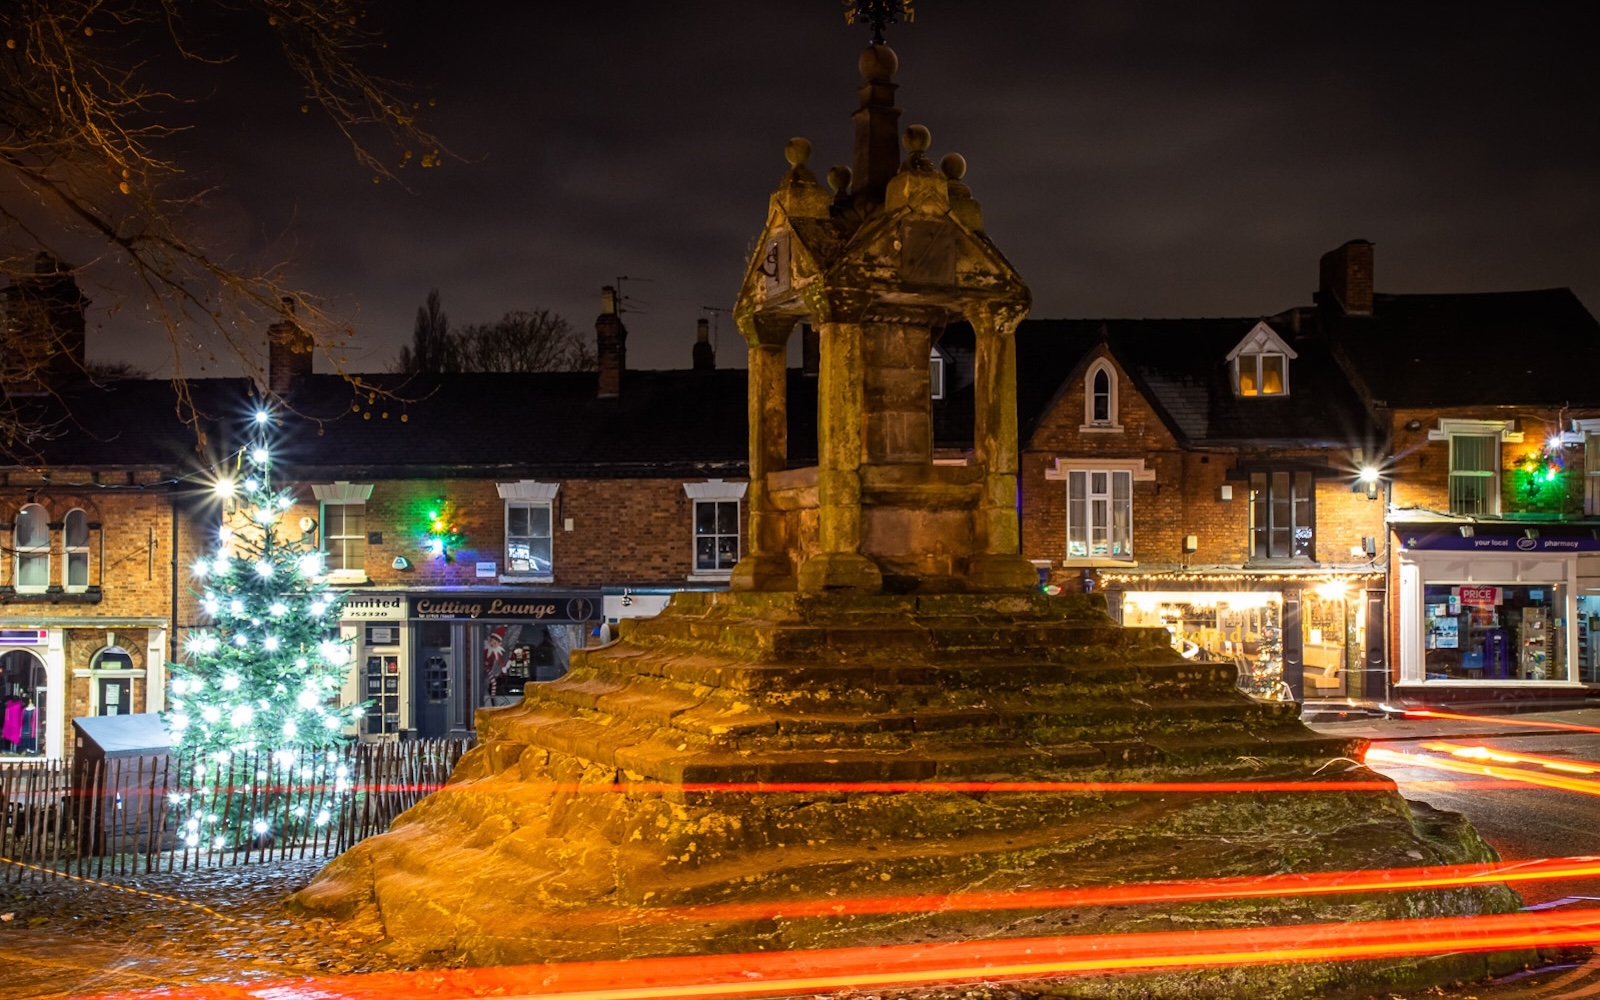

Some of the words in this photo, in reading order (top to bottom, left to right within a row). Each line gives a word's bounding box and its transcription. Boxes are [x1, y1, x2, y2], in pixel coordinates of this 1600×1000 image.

[1463, 589, 1491, 599] PRICE
[417, 598, 482, 618] Cutting
[488, 598, 556, 618] Lounge
